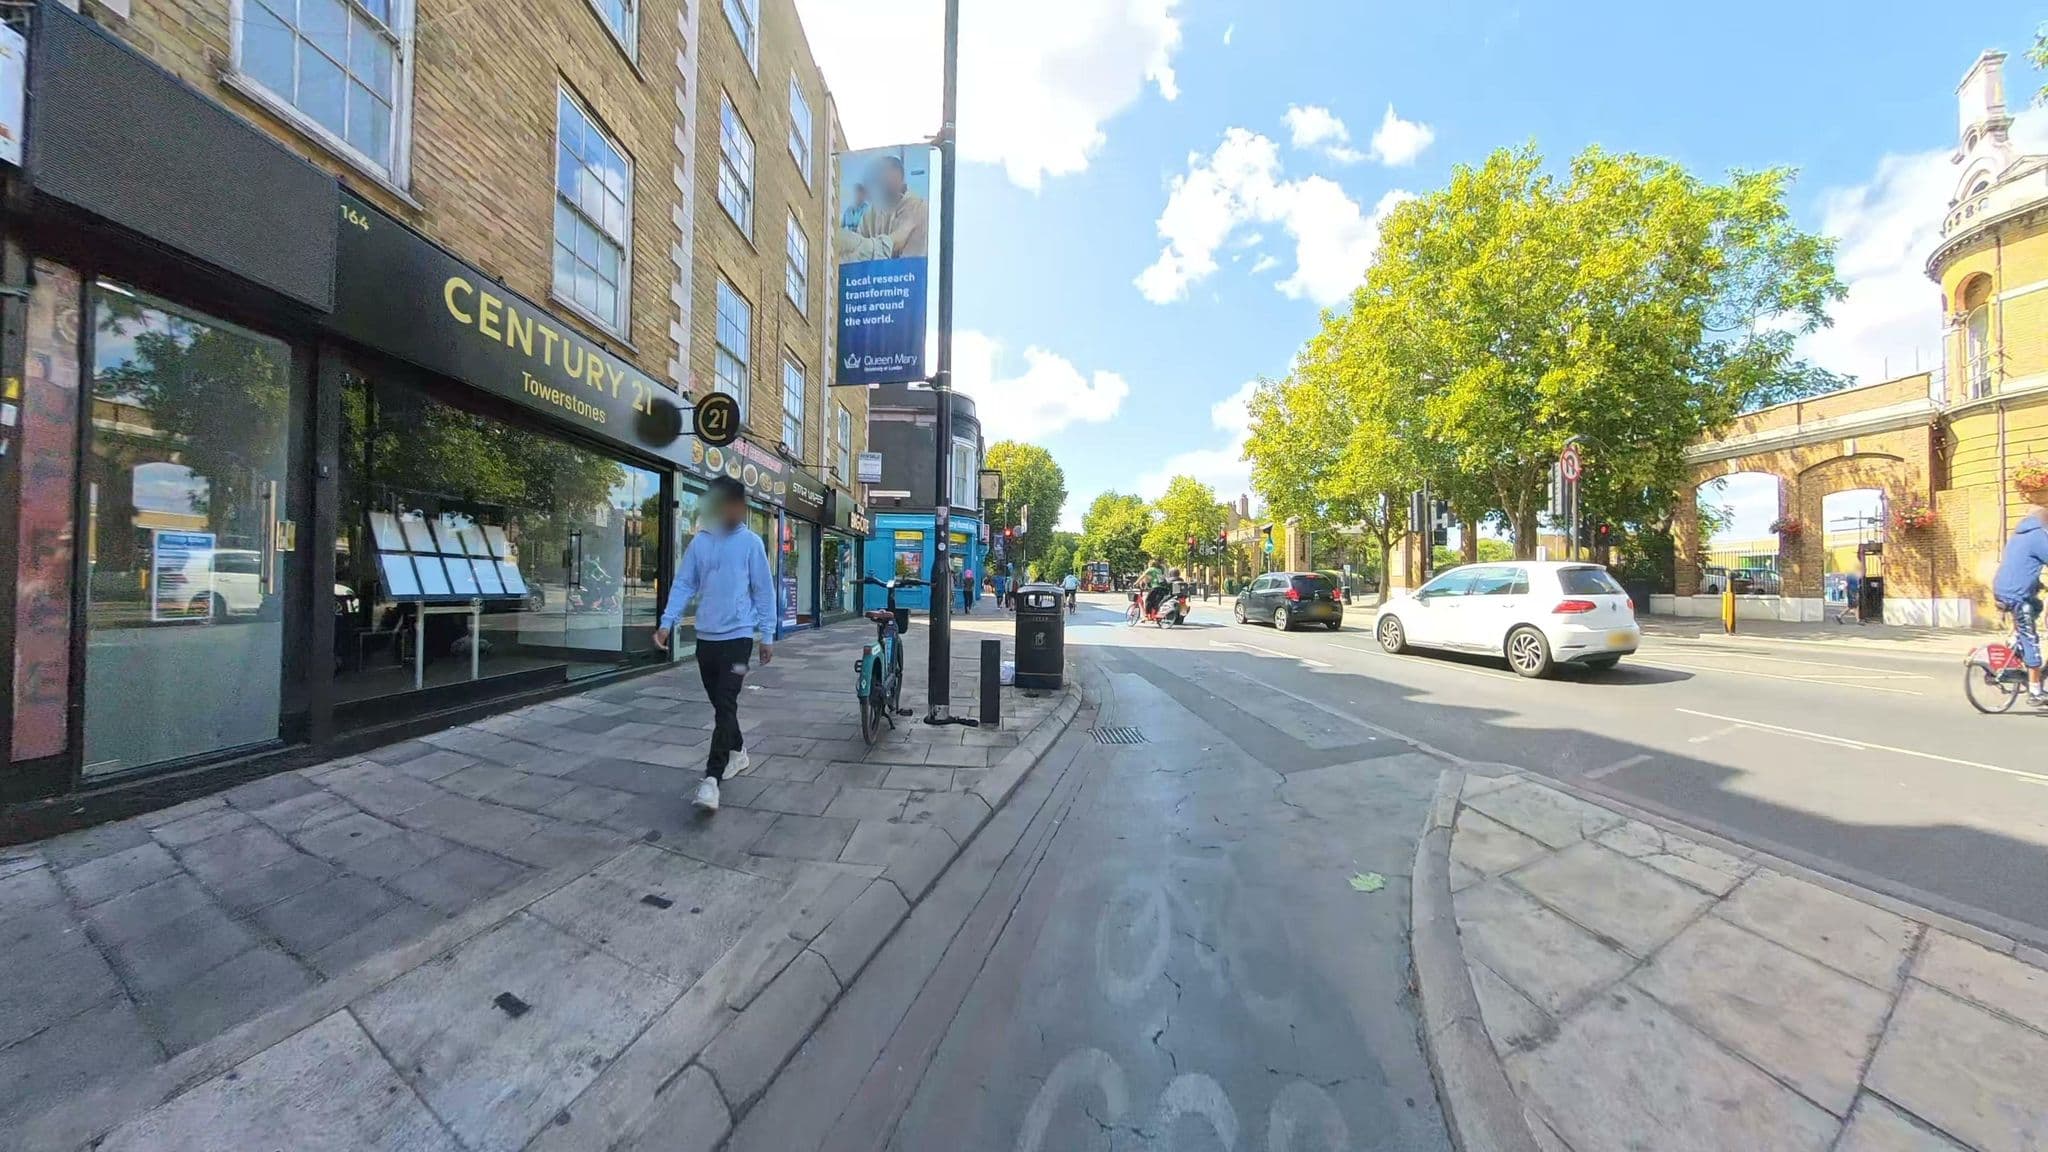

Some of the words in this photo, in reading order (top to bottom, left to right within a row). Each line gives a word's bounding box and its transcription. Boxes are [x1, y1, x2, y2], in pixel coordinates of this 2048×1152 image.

[340, 204, 370, 231] 164
[846, 276, 871, 286] Local
[873, 272, 915, 284] research
[846, 287, 909, 299] transforming
[845, 303, 867, 314] lives
[869, 300, 904, 311] around
[845, 317, 861, 326] the
[863, 314, 894, 324] world.
[443, 276, 625, 399] CENTURY
[631, 380, 653, 416] 21
[864, 355, 893, 366] Queen
[895, 353, 917, 365] Mary
[521, 370, 607, 424] Towerstones
[707, 408, 730, 430] 21
